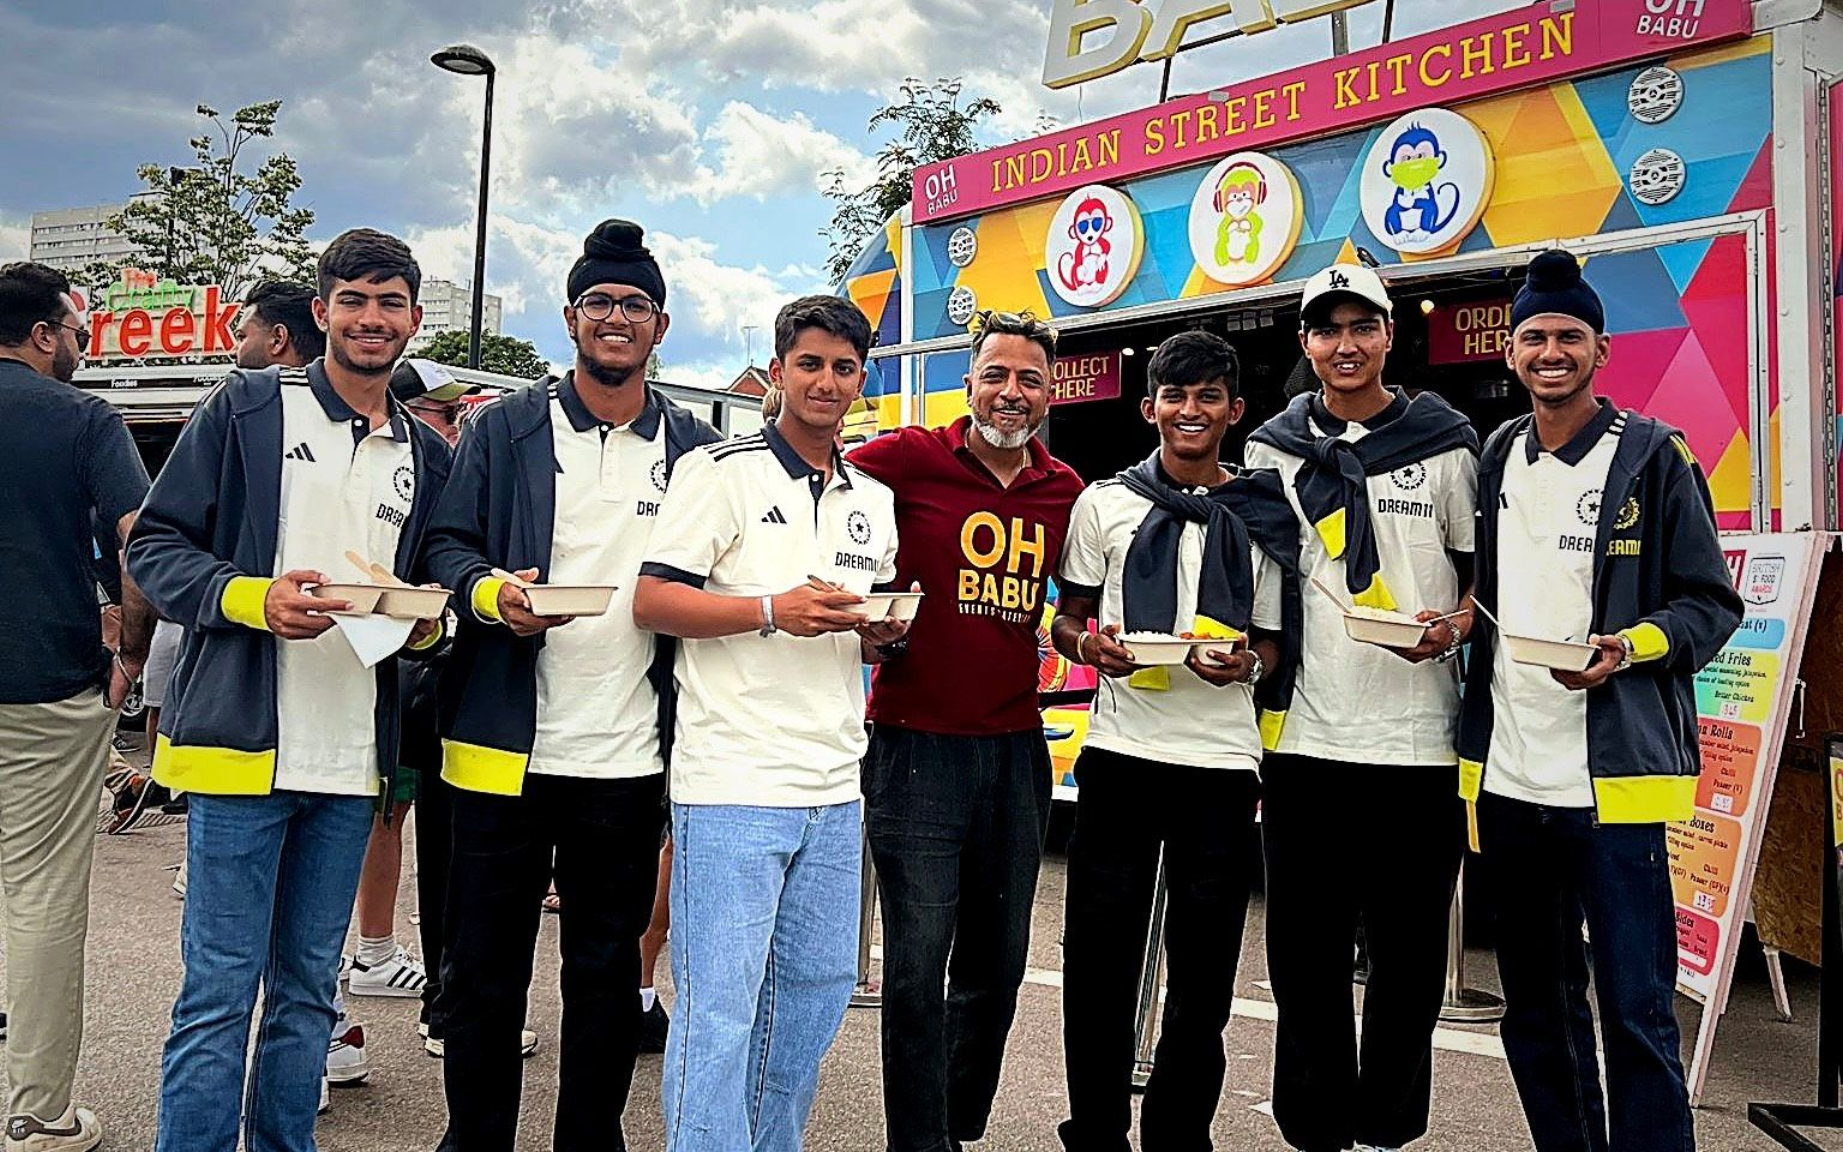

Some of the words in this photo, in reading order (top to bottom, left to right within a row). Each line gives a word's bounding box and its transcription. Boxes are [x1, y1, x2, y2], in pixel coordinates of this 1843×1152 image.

[1636, 15, 1699, 39] BABU
[1042, 0, 1383, 89] BA
[991, 129, 1121, 193] INDIAN
[1144, 81, 1306, 156] STREET
[1333, 11, 1575, 110] KITCHEN
[925, 164, 956, 200] OH
[928, 189, 958, 215] BABU
[1329, 269, 1350, 289] LA
[106, 279, 194, 315] Crafty
[71, 286, 243, 360] reek
[1464, 330, 1509, 355] HER
[1053, 356, 1110, 381] OLLECT
[1055, 378, 1096, 400] HERE
[374, 503, 405, 528] DREA
[1378, 499, 1433, 518] DREAM11
[960, 511, 1044, 578] OH
[1557, 535, 1594, 553] DREA
[958, 569, 1040, 611] BABU
[1727, 652, 1752, 667] Fries
[1710, 724, 1734, 740] Rolls
[1690, 815, 1715, 833] Boxes
